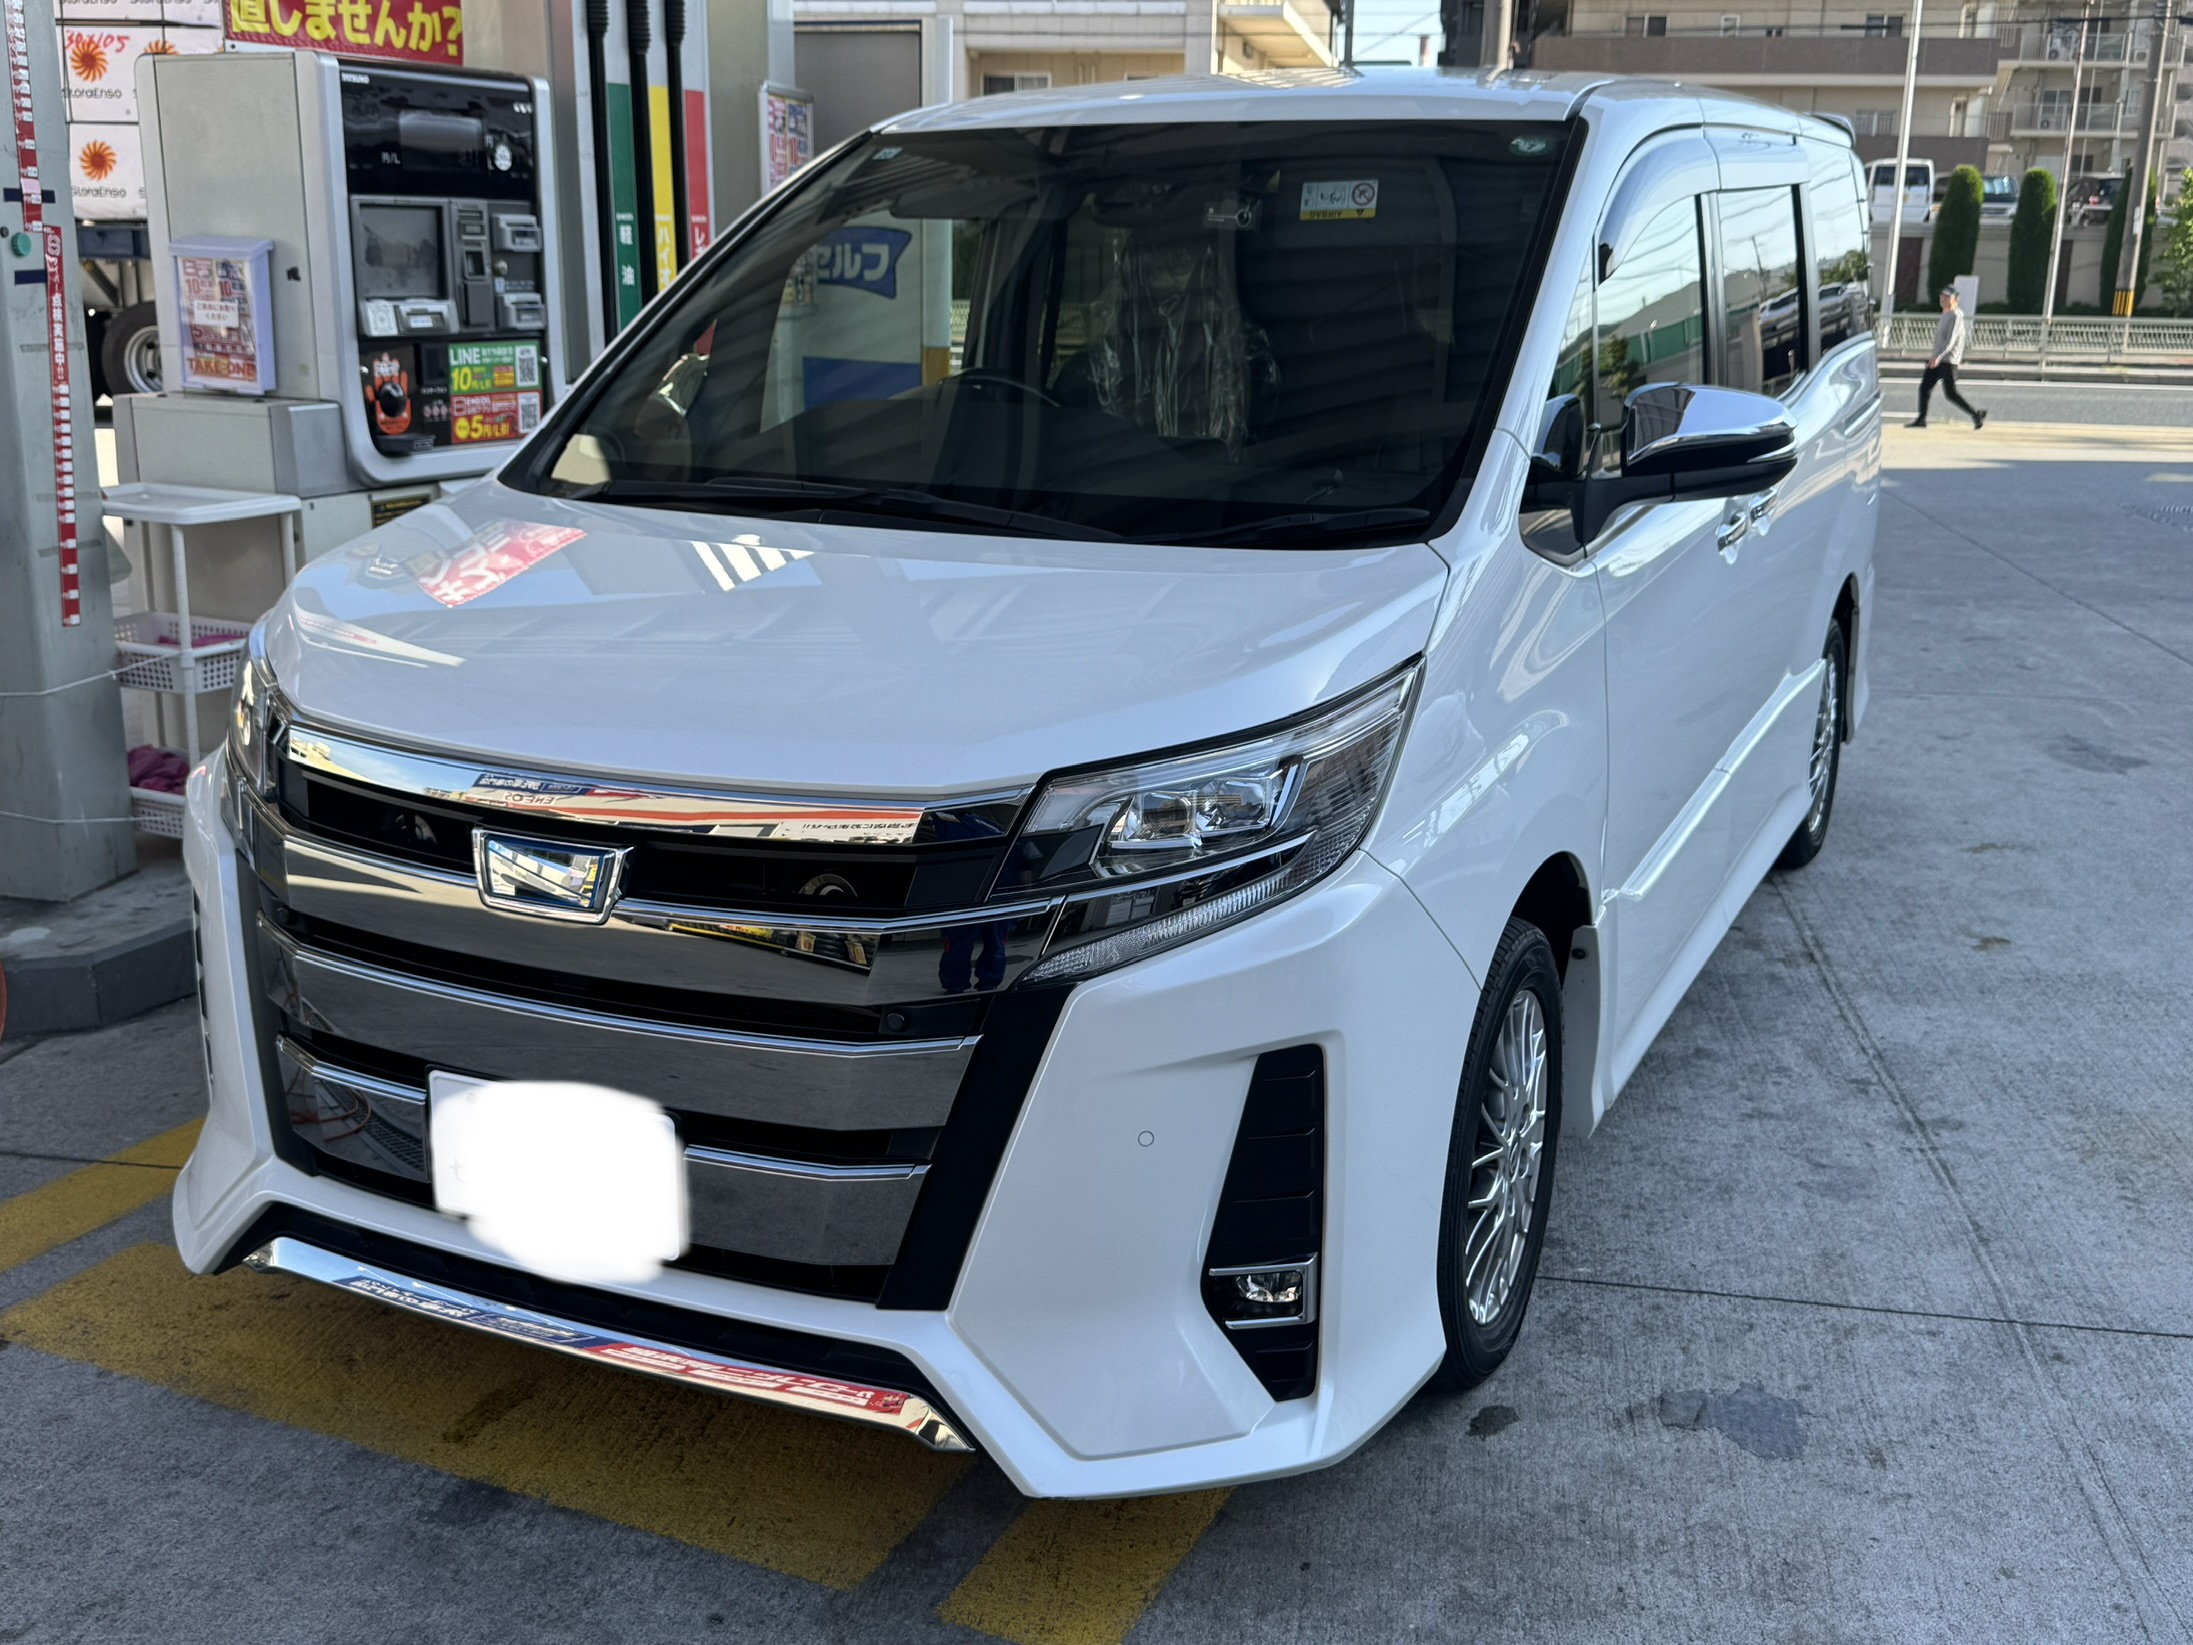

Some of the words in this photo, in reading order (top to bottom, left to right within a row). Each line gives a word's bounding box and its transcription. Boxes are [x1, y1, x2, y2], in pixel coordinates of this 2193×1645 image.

[231, 0, 462, 56] 直しませんか?
[449, 346, 481, 366] LINE
